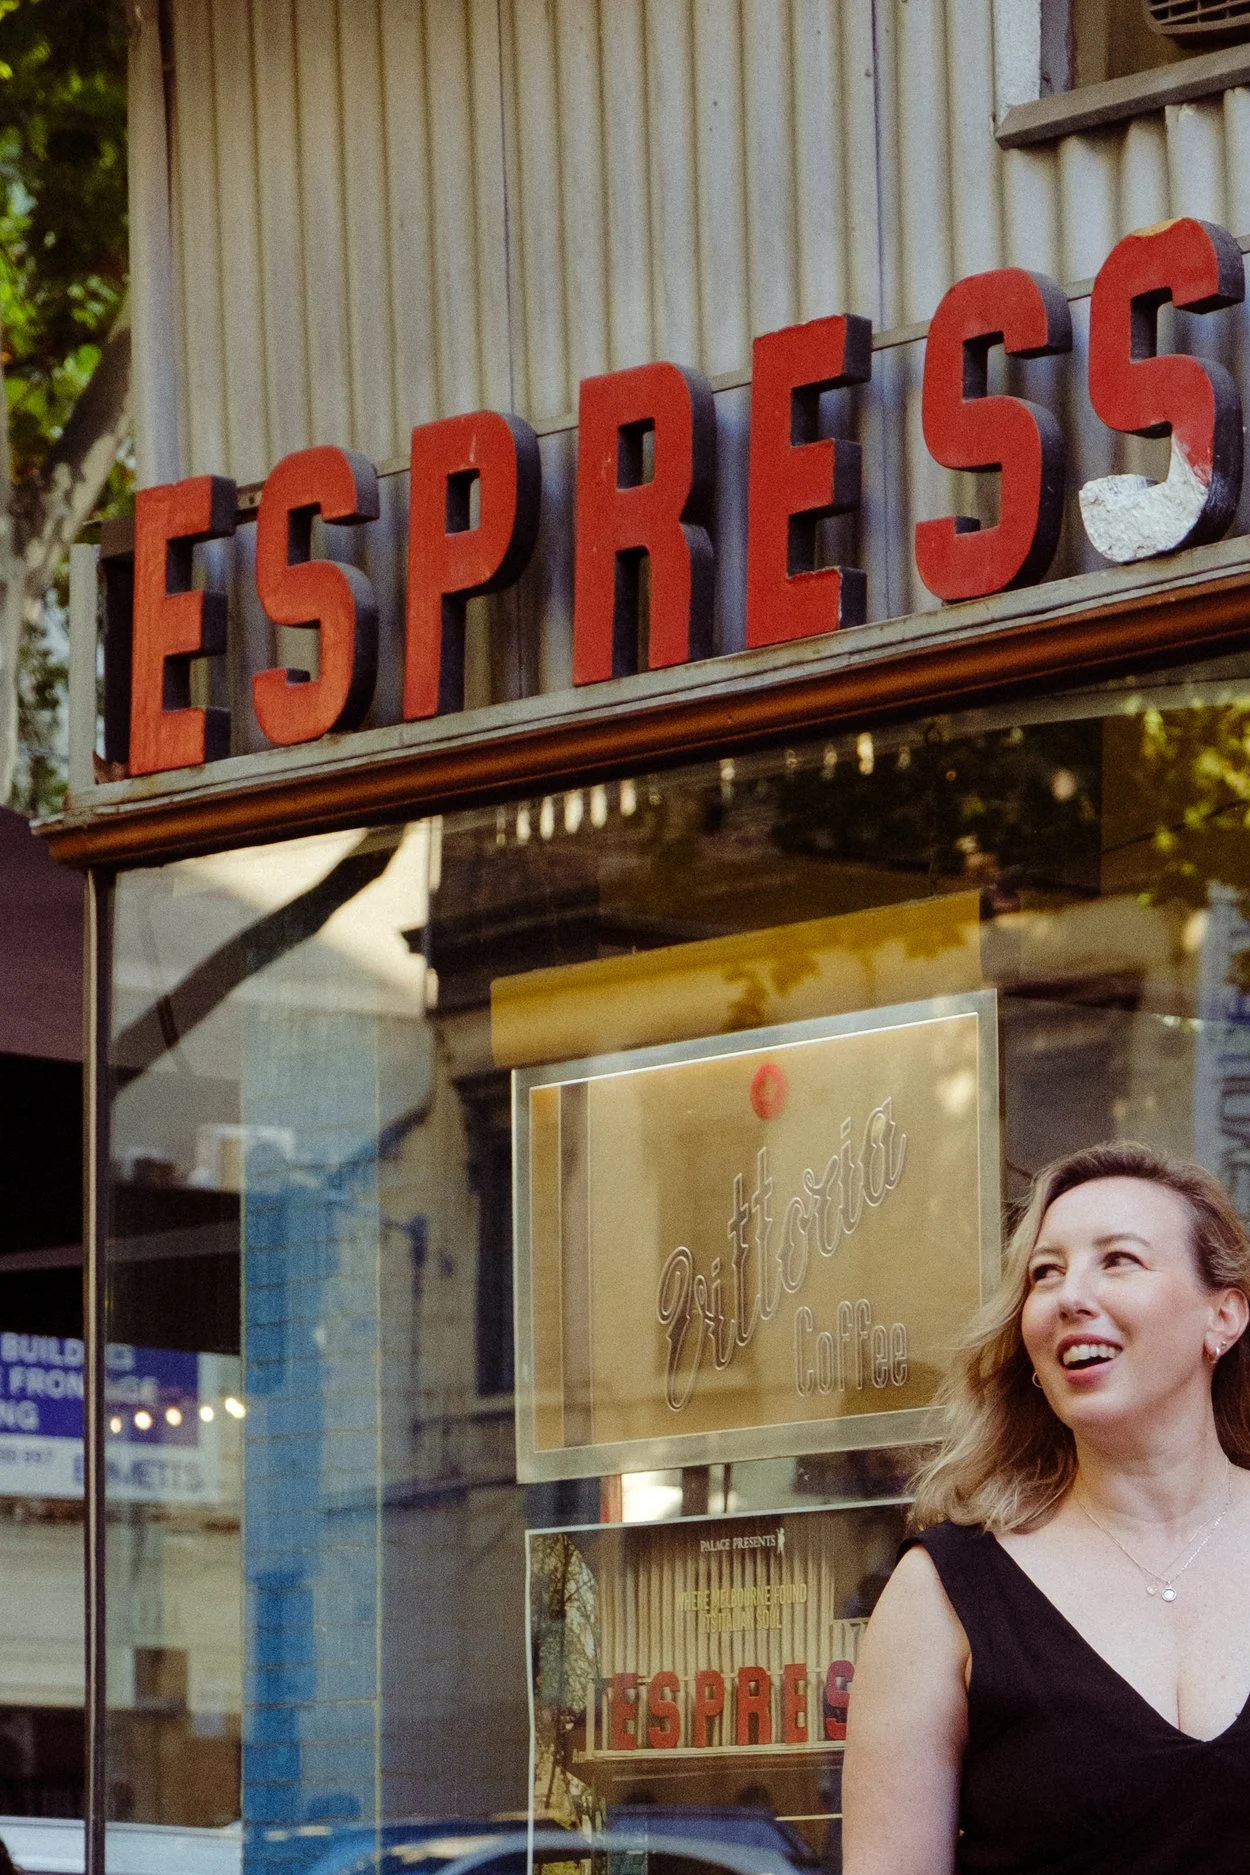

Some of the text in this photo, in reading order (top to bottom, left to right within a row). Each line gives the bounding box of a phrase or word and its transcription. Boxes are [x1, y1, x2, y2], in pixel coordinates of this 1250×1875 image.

[658, 1097, 906, 1411] Vittoria
[795, 1299, 907, 1397] Coffee
[700, 1535, 776, 1552] PALACE PRESENTS
[675, 1583, 807, 1611] WHERE MELBOURNE FOUND
[756, 1608, 782, 1630] SOUL
